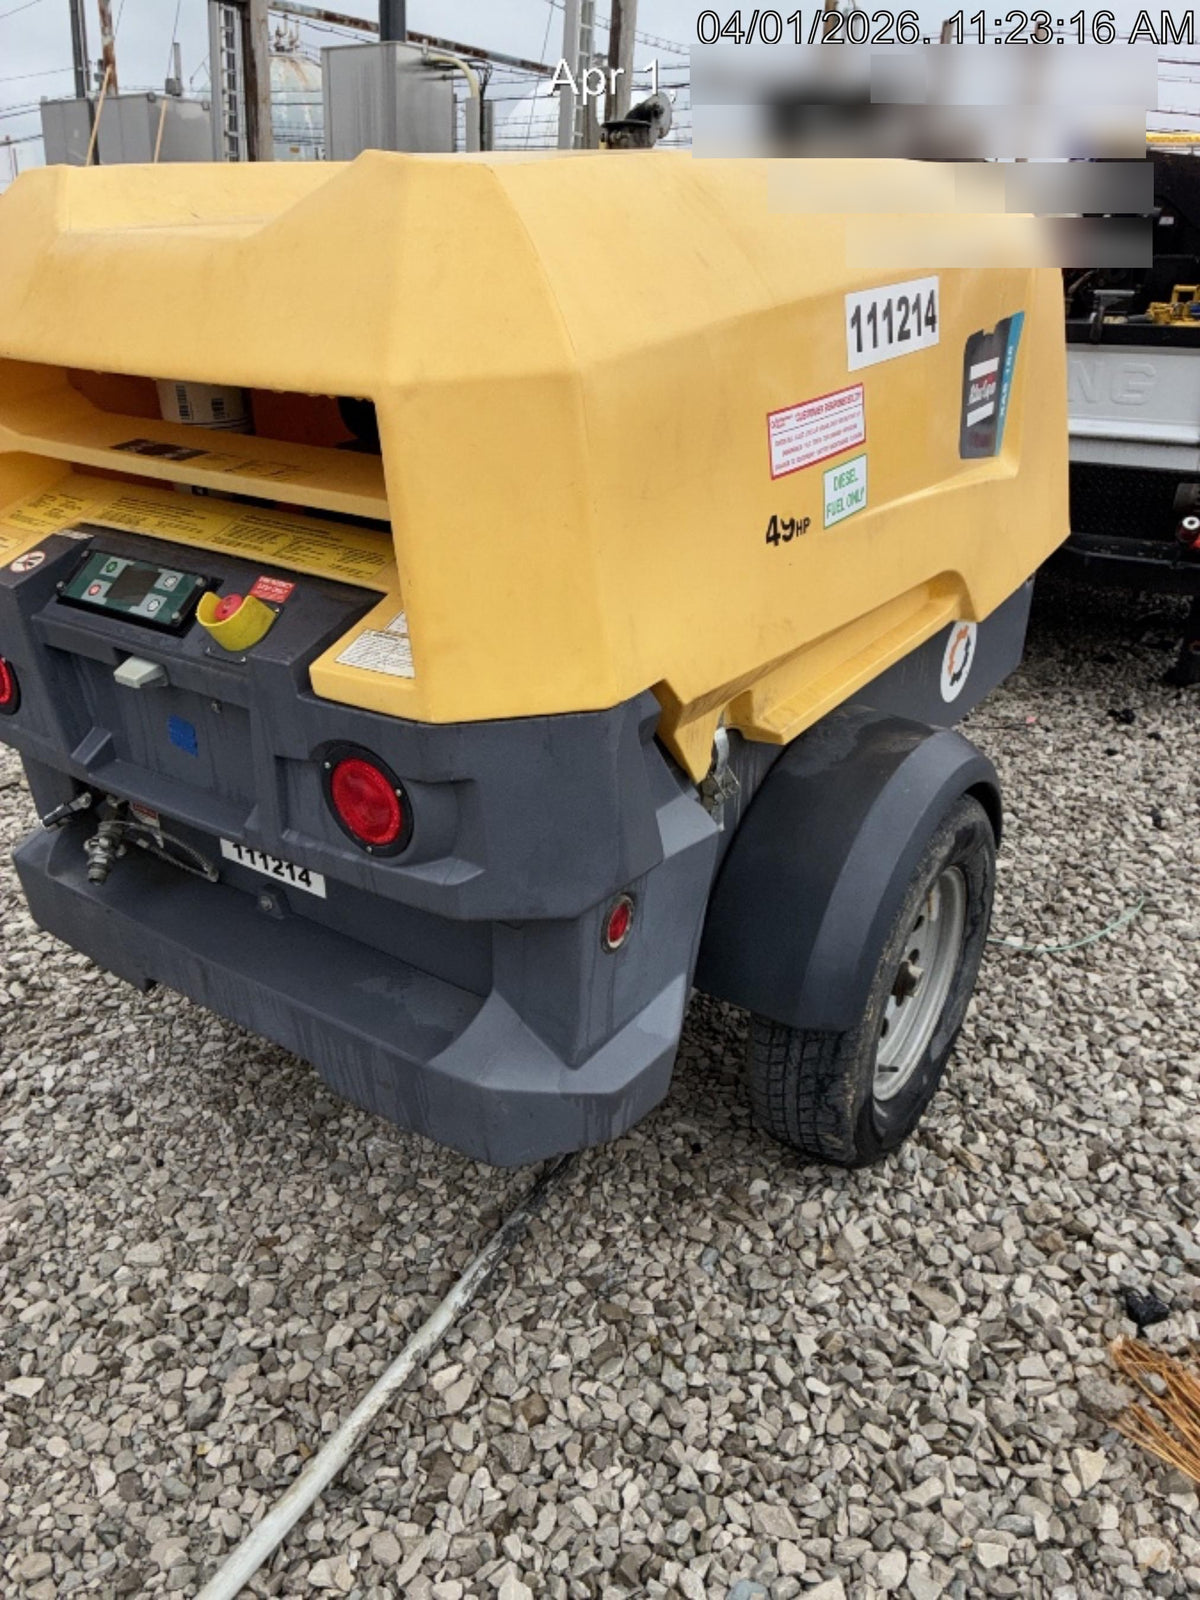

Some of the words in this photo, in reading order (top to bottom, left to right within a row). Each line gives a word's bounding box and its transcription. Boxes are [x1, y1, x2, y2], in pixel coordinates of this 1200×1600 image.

[850, 288, 937, 353] 111214
[833, 467, 859, 491] DIESEL
[826, 497, 845, 519] FUEL
[845, 486, 865, 507] ONLY
[232, 843, 312, 888] 111214
